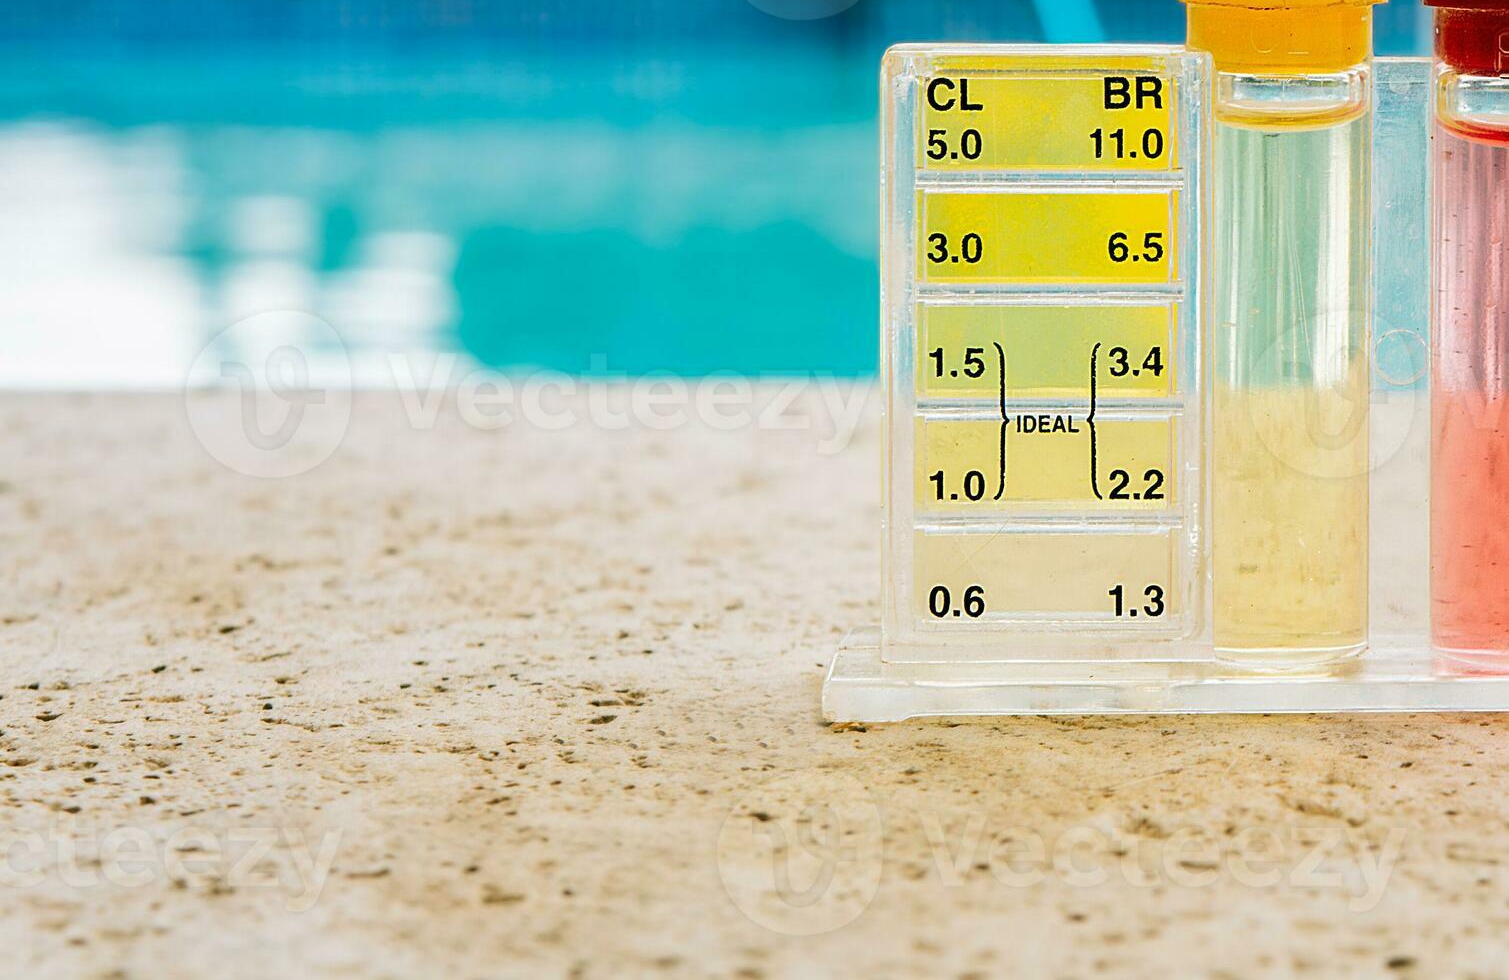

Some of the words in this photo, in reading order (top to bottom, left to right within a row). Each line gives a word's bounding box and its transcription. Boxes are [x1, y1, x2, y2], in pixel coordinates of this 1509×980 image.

[927, 77, 984, 111] CL
[1103, 76, 1163, 109] BR
[926, 128, 982, 160] 5.0
[1089, 128, 1164, 159] 11.0
[927, 233, 983, 263] 3.0
[1108, 232, 1164, 263] 6.5
[929, 347, 985, 378] 1.5
[1108, 347, 1164, 377] 3.4
[1016, 415, 1080, 434] IDEAL
[929, 470, 986, 501] 1.0
[1108, 470, 1165, 500] 2.2
[929, 586, 985, 617] 0.6
[1108, 585, 1165, 617] 1.3
